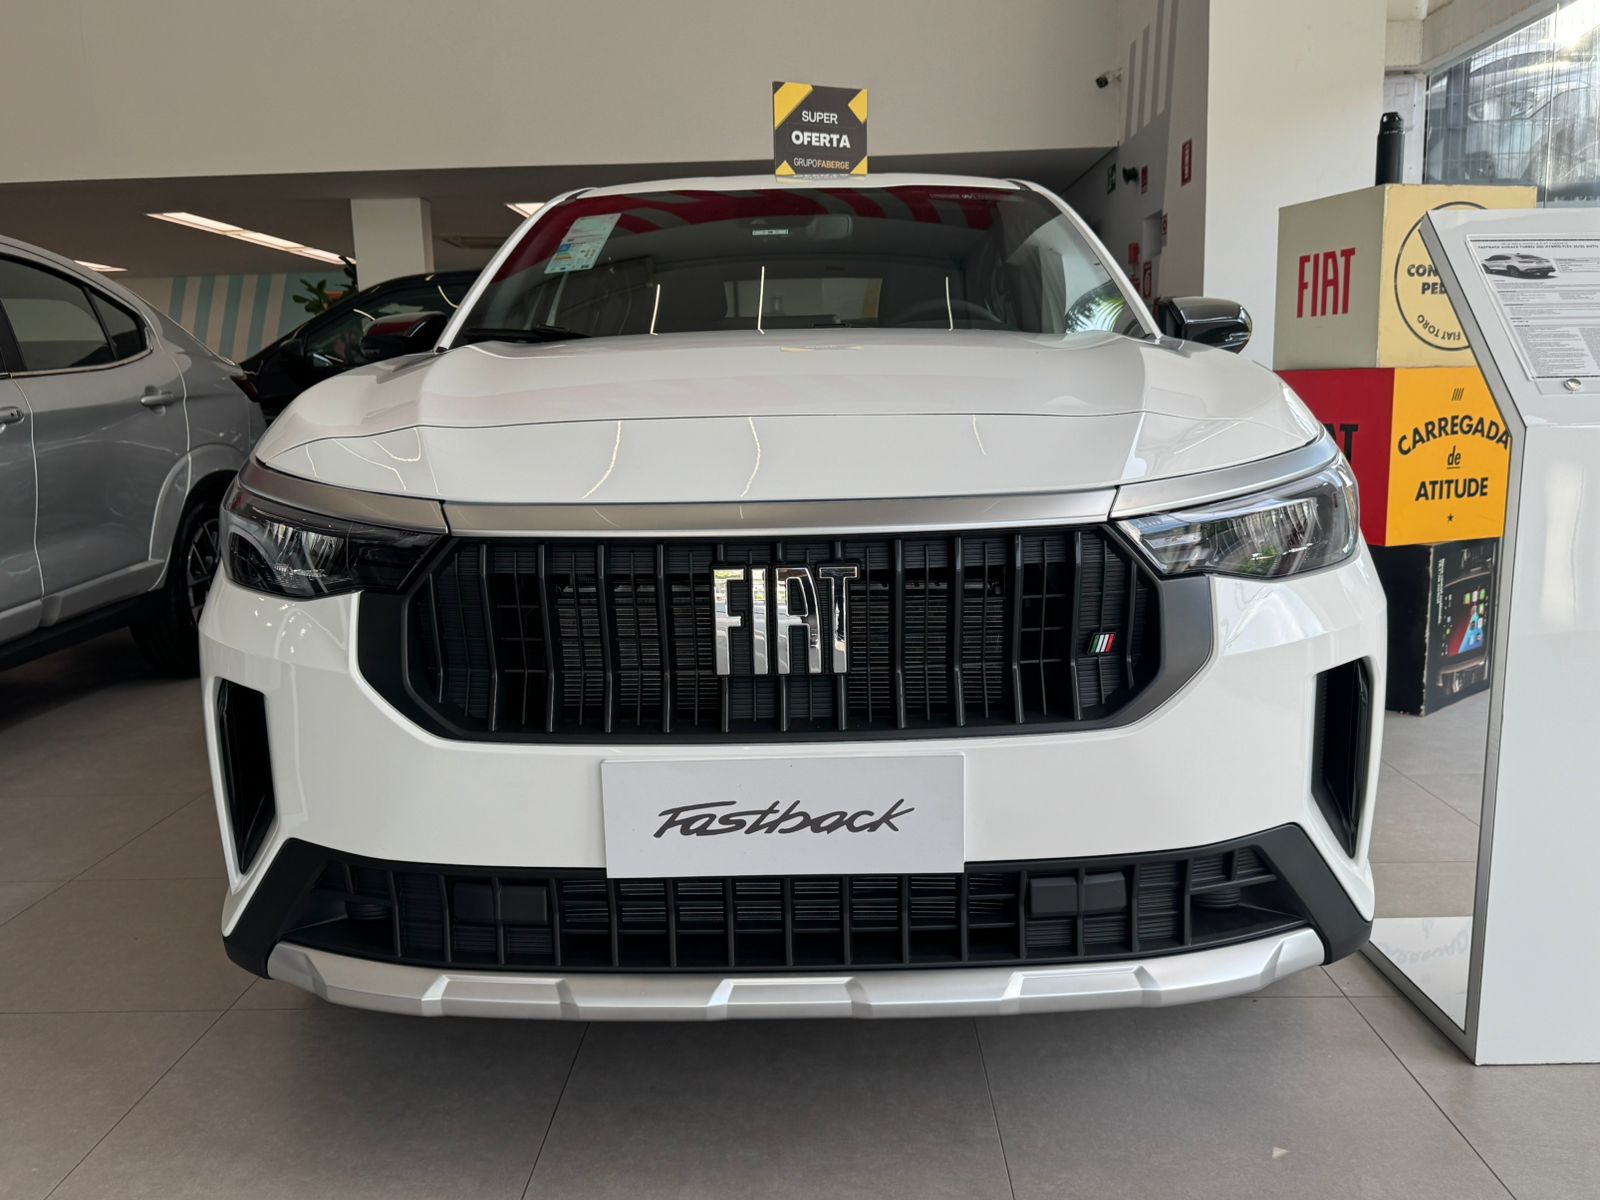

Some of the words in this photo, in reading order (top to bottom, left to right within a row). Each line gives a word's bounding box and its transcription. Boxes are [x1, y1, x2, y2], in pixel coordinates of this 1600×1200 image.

[802, 110, 838, 124] SUPER
[791, 130, 851, 148] OFERTA
[1297, 247, 1356, 319] FIAT
[1417, 314, 1440, 338] TORO
[1441, 330, 1461, 341] FIAT
[1397, 414, 1512, 456] CARREGADA
[1447, 446, 1461, 467] de
[1415, 477, 1489, 501] ATITUDE
[713, 566, 858, 675] FIAT
[653, 798, 915, 838] Fastback
